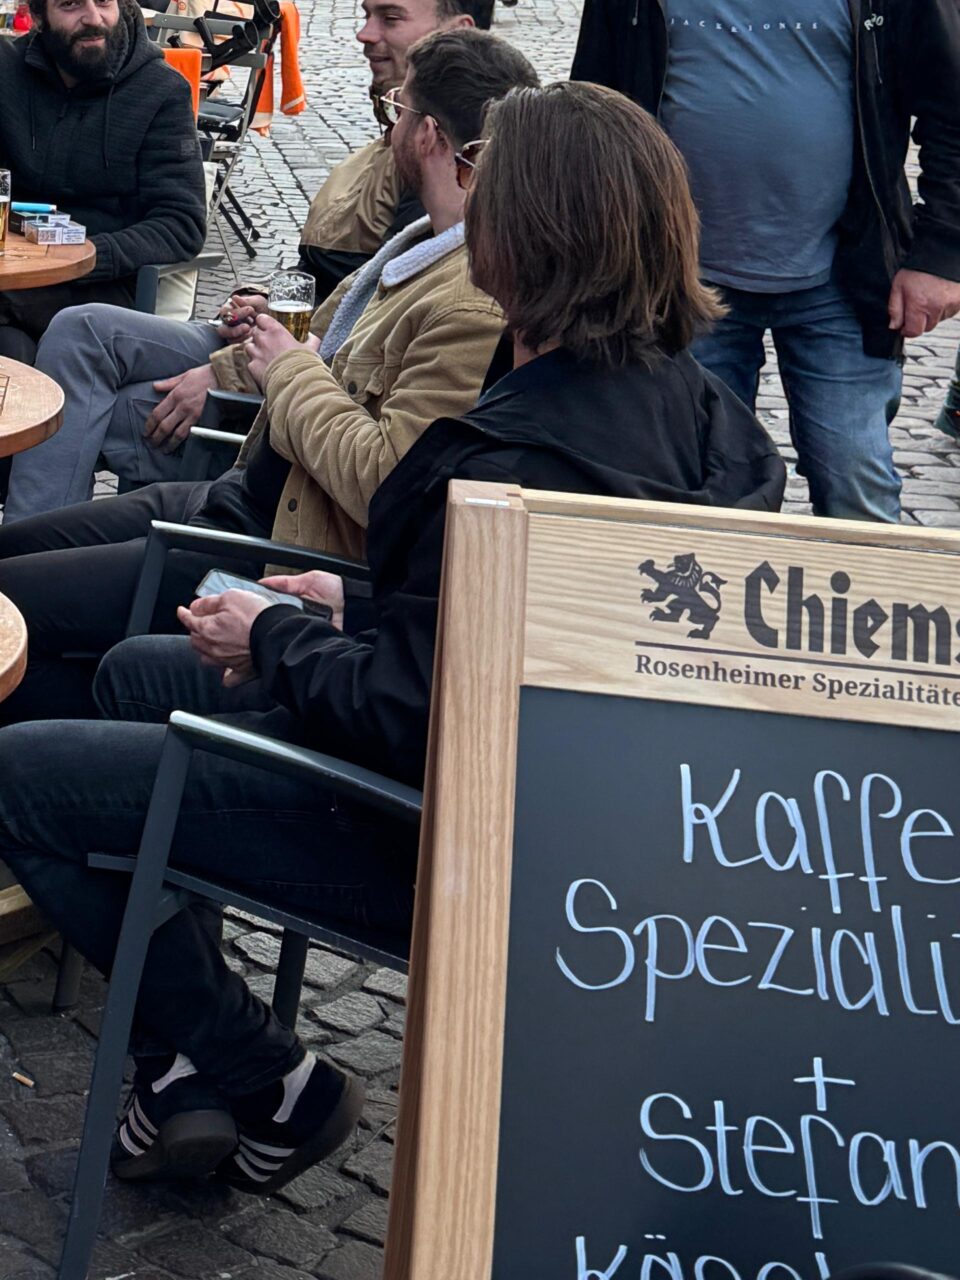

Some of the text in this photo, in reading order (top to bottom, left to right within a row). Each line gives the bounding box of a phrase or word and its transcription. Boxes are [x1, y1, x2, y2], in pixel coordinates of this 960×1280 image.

[744, 560, 960, 666] Chiem
[635, 655, 807, 690] Rosenheimer
[556, 878, 960, 1024] Speziali
